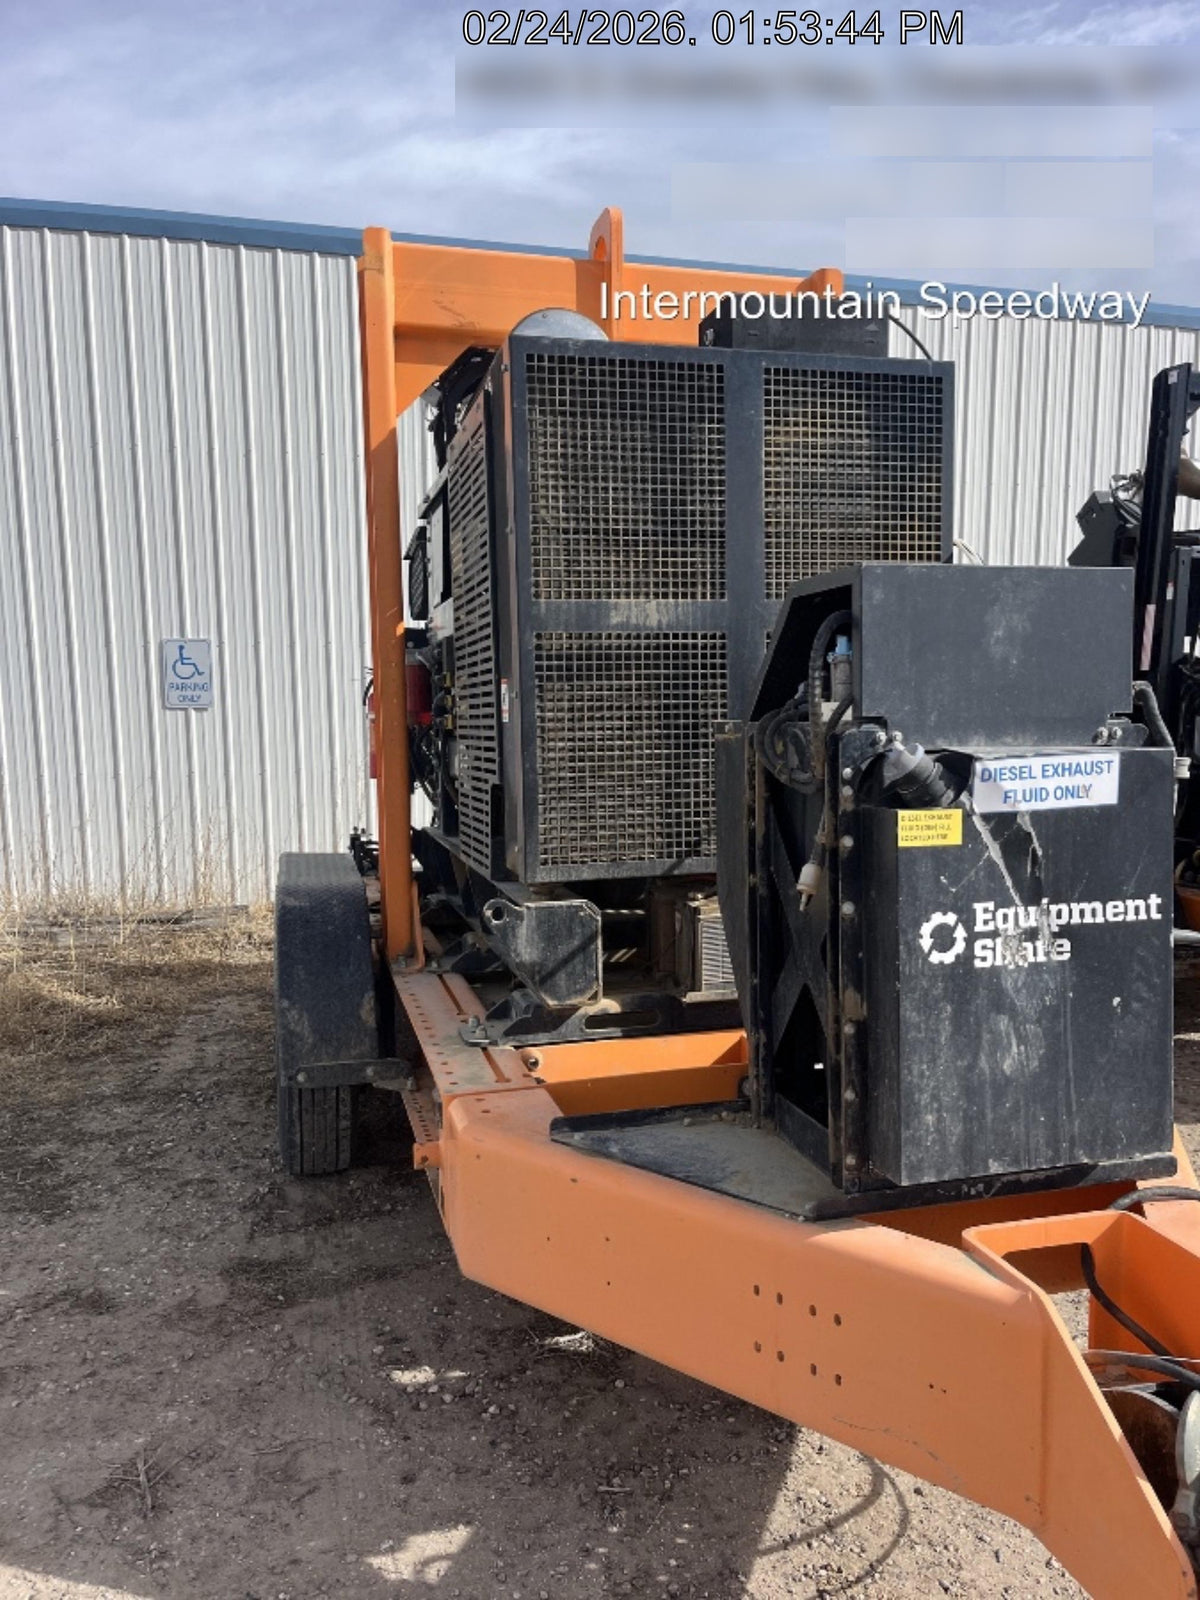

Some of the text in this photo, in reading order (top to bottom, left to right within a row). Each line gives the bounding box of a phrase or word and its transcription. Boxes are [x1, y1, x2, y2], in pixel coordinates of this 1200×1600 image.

[169, 682, 208, 692] PARKING
[177, 694, 201, 703] ONLY
[980, 760, 1114, 783] DIESEL EXHAUST
[1003, 783, 1093, 804] FLUID ONLY
